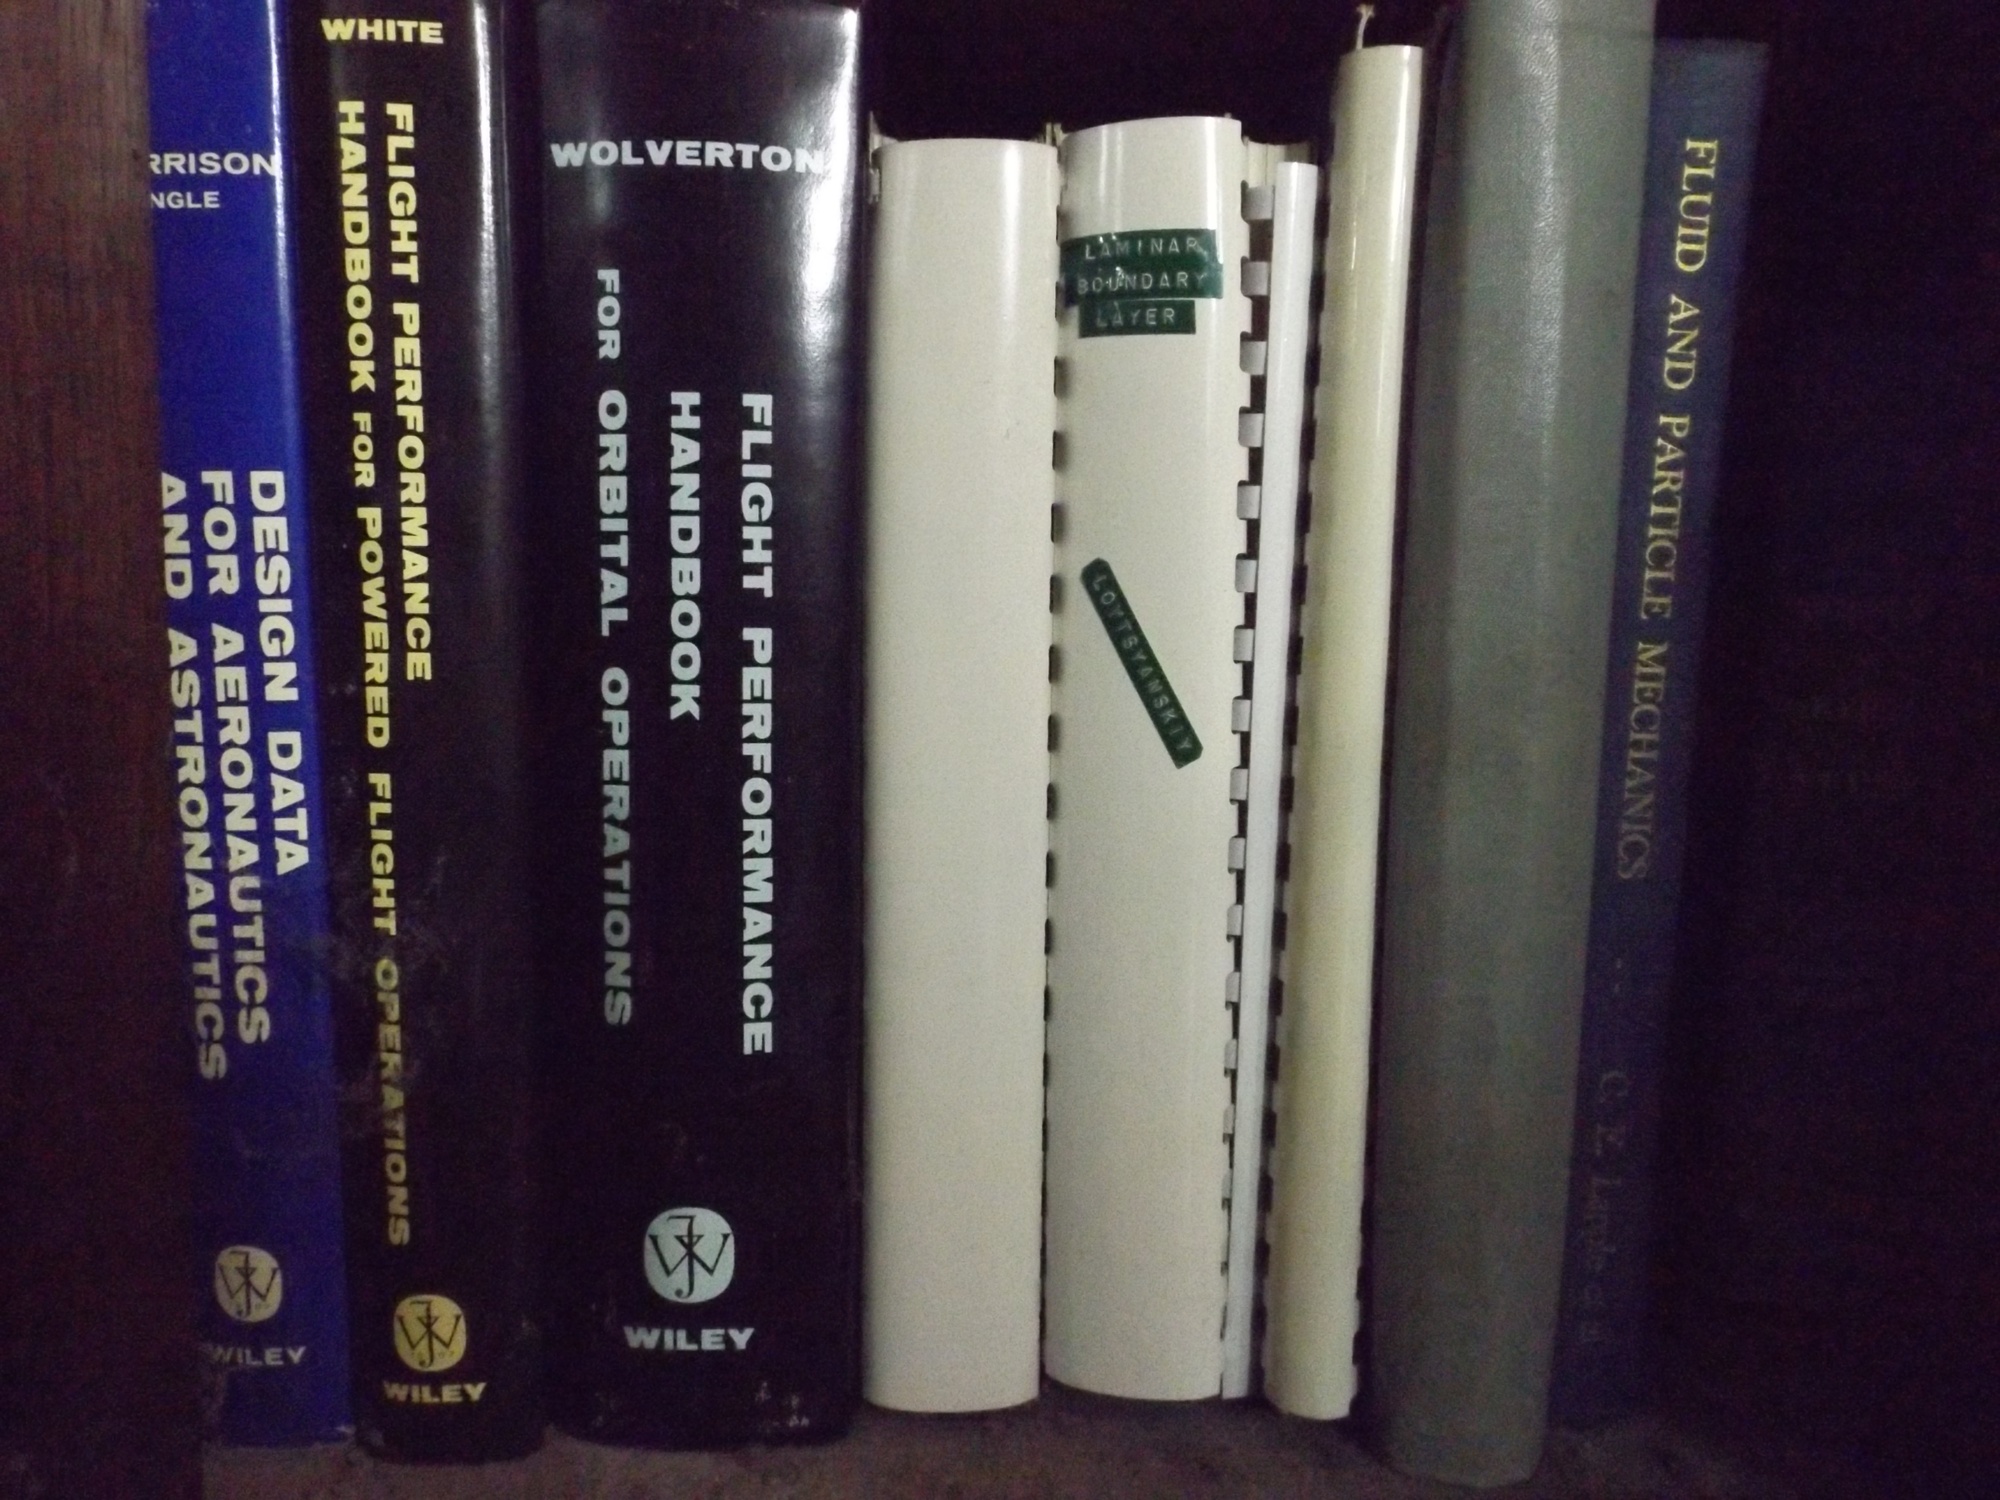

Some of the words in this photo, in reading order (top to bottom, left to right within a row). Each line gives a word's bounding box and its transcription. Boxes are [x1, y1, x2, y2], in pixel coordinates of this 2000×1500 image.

[320, 18, 444, 45] WHITE
[386, 102, 420, 284] FLIGHT
[549, 139, 825, 174] WOLVERTON
[1674, 138, 1719, 273] FLUID
[338, 100, 376, 393] HANDBOOK
[597, 269, 621, 360] FOR
[1077, 271, 1207, 296] BOUNDARY
[1084, 236, 1206, 260] LAMINAR
[1096, 306, 1175, 328] LAYER
[1663, 293, 1701, 390] AND
[161, 471, 194, 599] AND
[201, 470, 242, 596] FOR
[353, 411, 376, 488] FOR
[393, 302, 433, 681] PERFORMANCE
[598, 389, 629, 637] ORBITAL
[741, 393, 774, 598] FLIGHT
[1640, 413, 1691, 620] PARTICLE
[250, 470, 300, 701] DESIGN
[357, 507, 391, 749] POWERED
[669, 391, 702, 721] HANDBOOK
[211, 621, 271, 1045] AERONAUTICS
[267, 731, 310, 876] DATA
[601, 666, 632, 1026] OPERATIONS
[741, 627, 775, 1056] PERFORMANCE
[1617, 641, 1669, 881] MECHANICS
[167, 627, 228, 1081] ASTRONAUTICS
[368, 772, 397, 936] FLIGHT
[375, 958, 411, 1246] OPERATIONS
[383, 1381, 487, 1404] WILEY
[623, 1325, 755, 1352] WILEY
